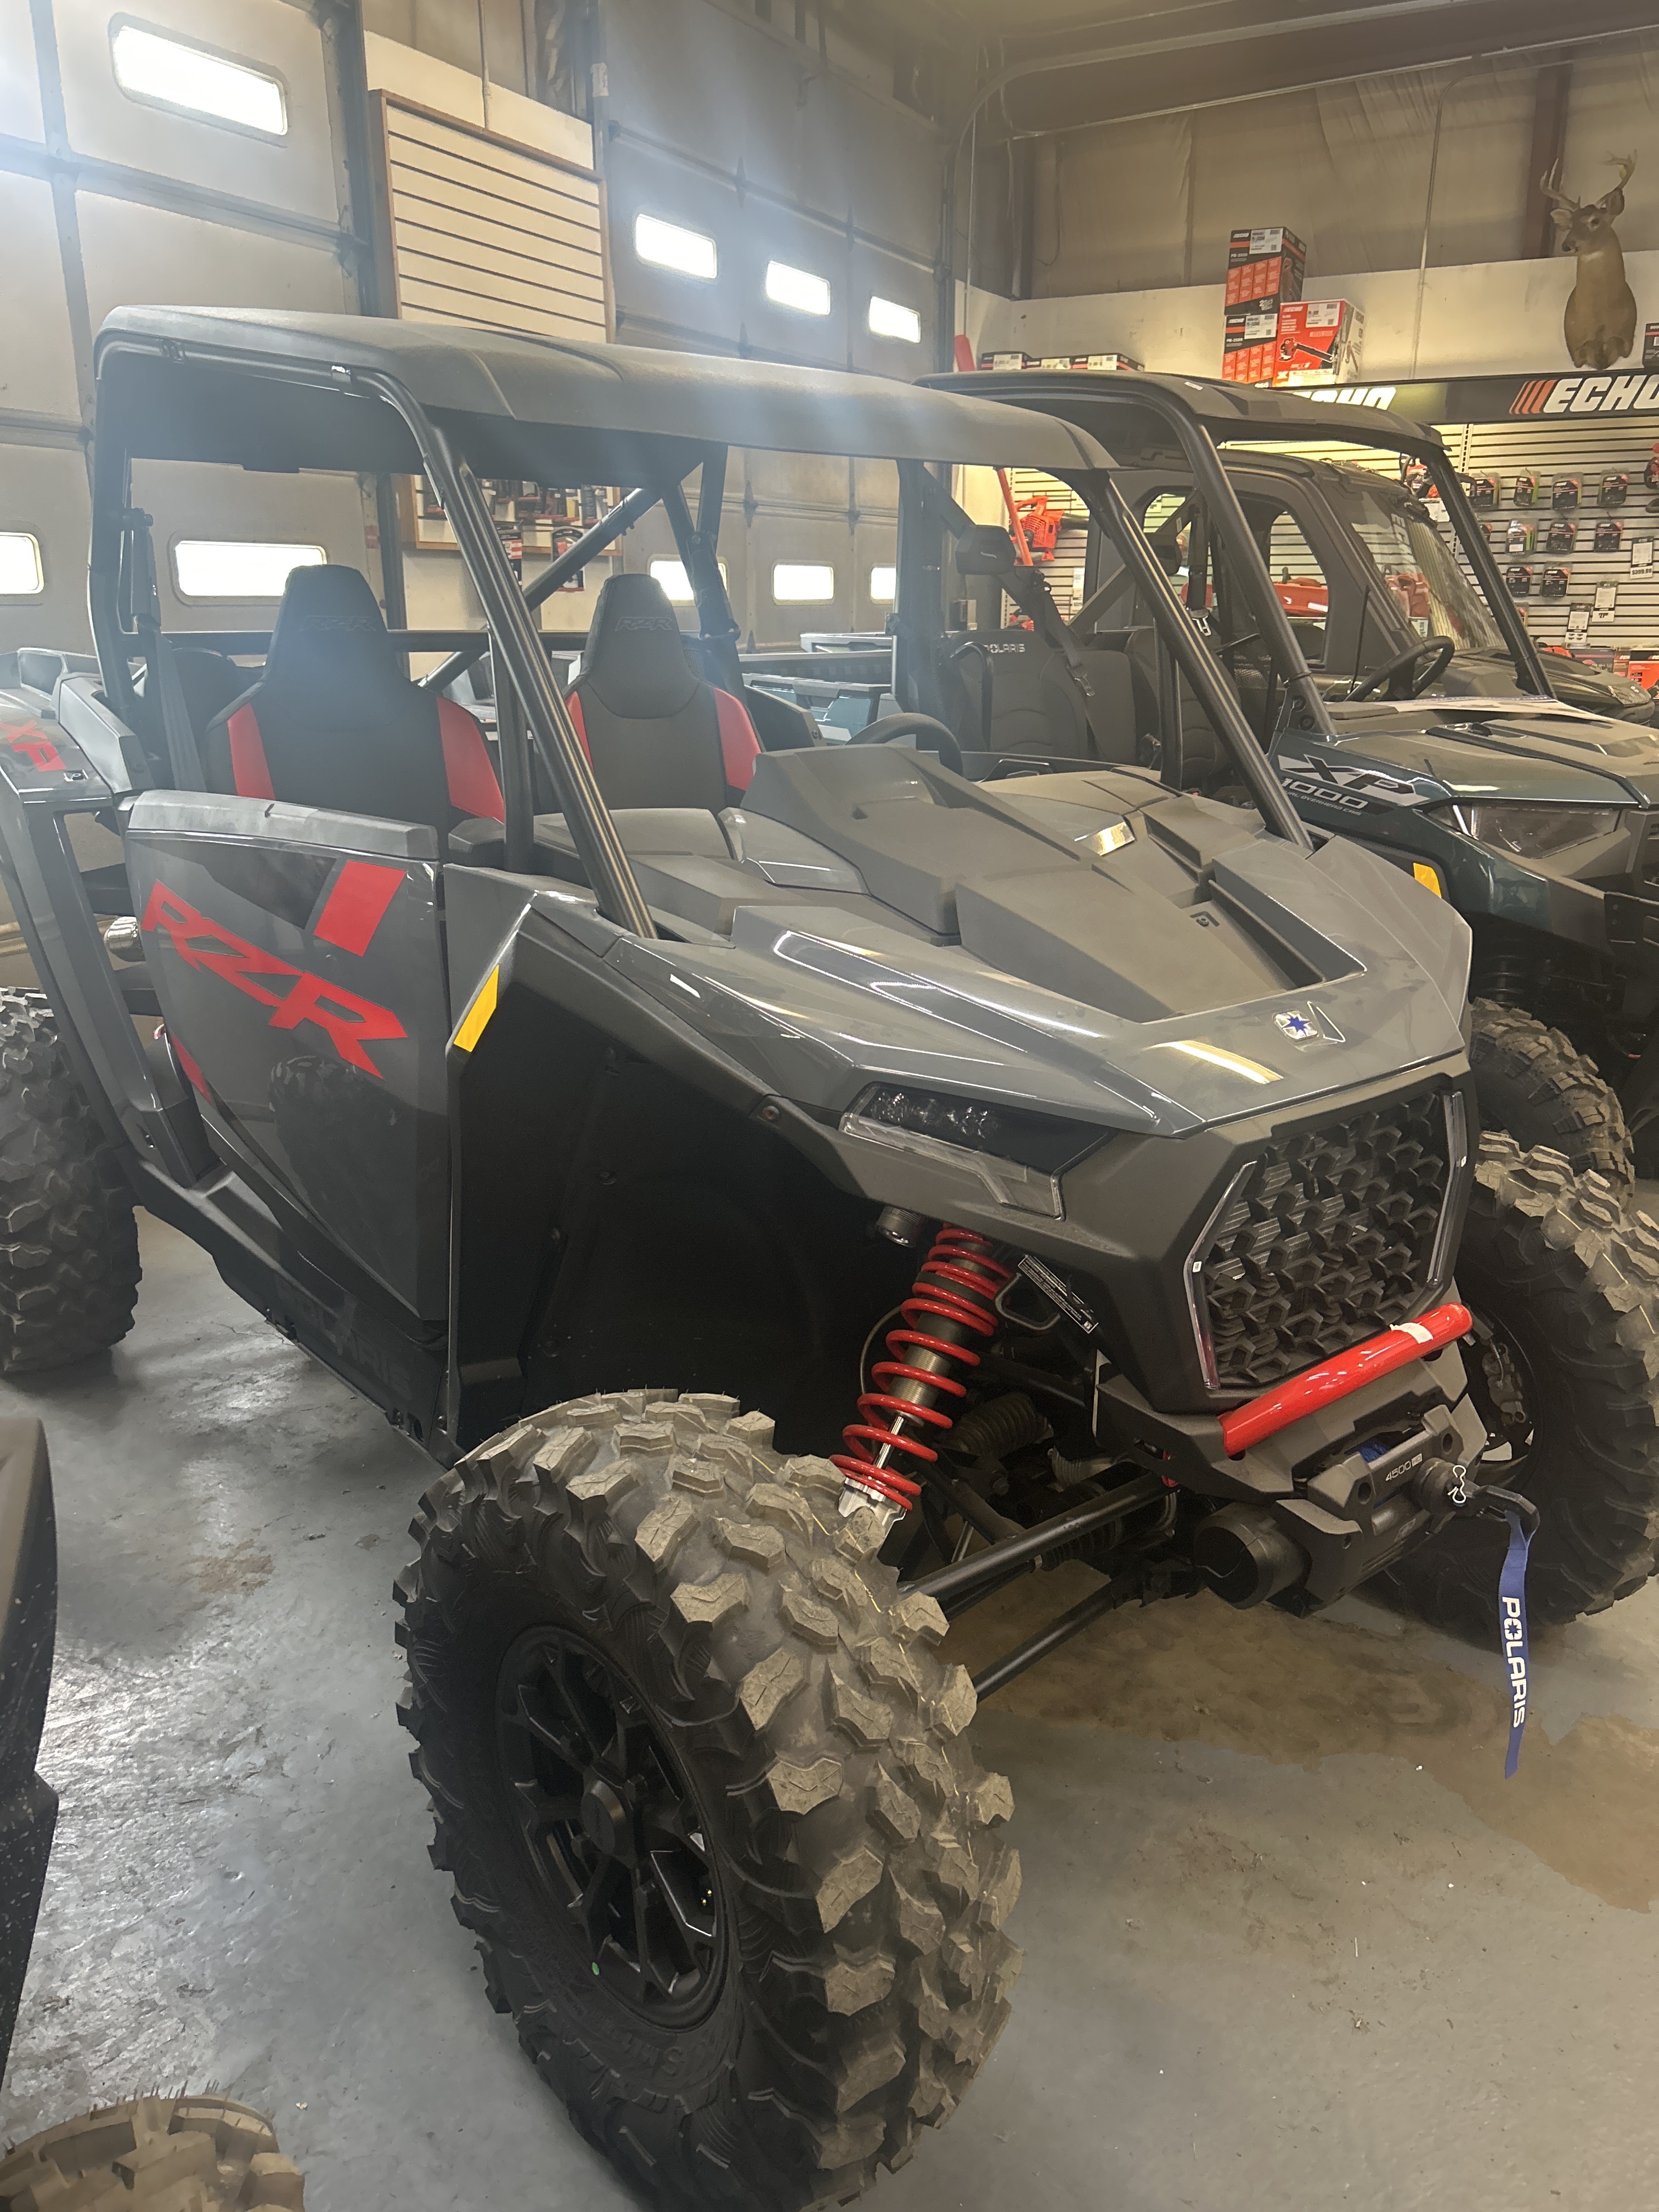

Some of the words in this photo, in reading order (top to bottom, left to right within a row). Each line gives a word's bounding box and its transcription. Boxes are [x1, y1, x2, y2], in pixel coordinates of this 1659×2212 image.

[1293, 387, 1396, 410] HO
[1543, 374, 1659, 413] ECHO
[614, 617, 673, 631] RZR
[0, 720, 67, 772] XP
[1280, 754, 1417, 794] XP
[1281, 778, 1369, 809] 1000
[141, 879, 408, 1080] RZR
[1385, 1460, 1411, 1481] 4500
[1502, 1596, 1527, 1728] POLARIS
